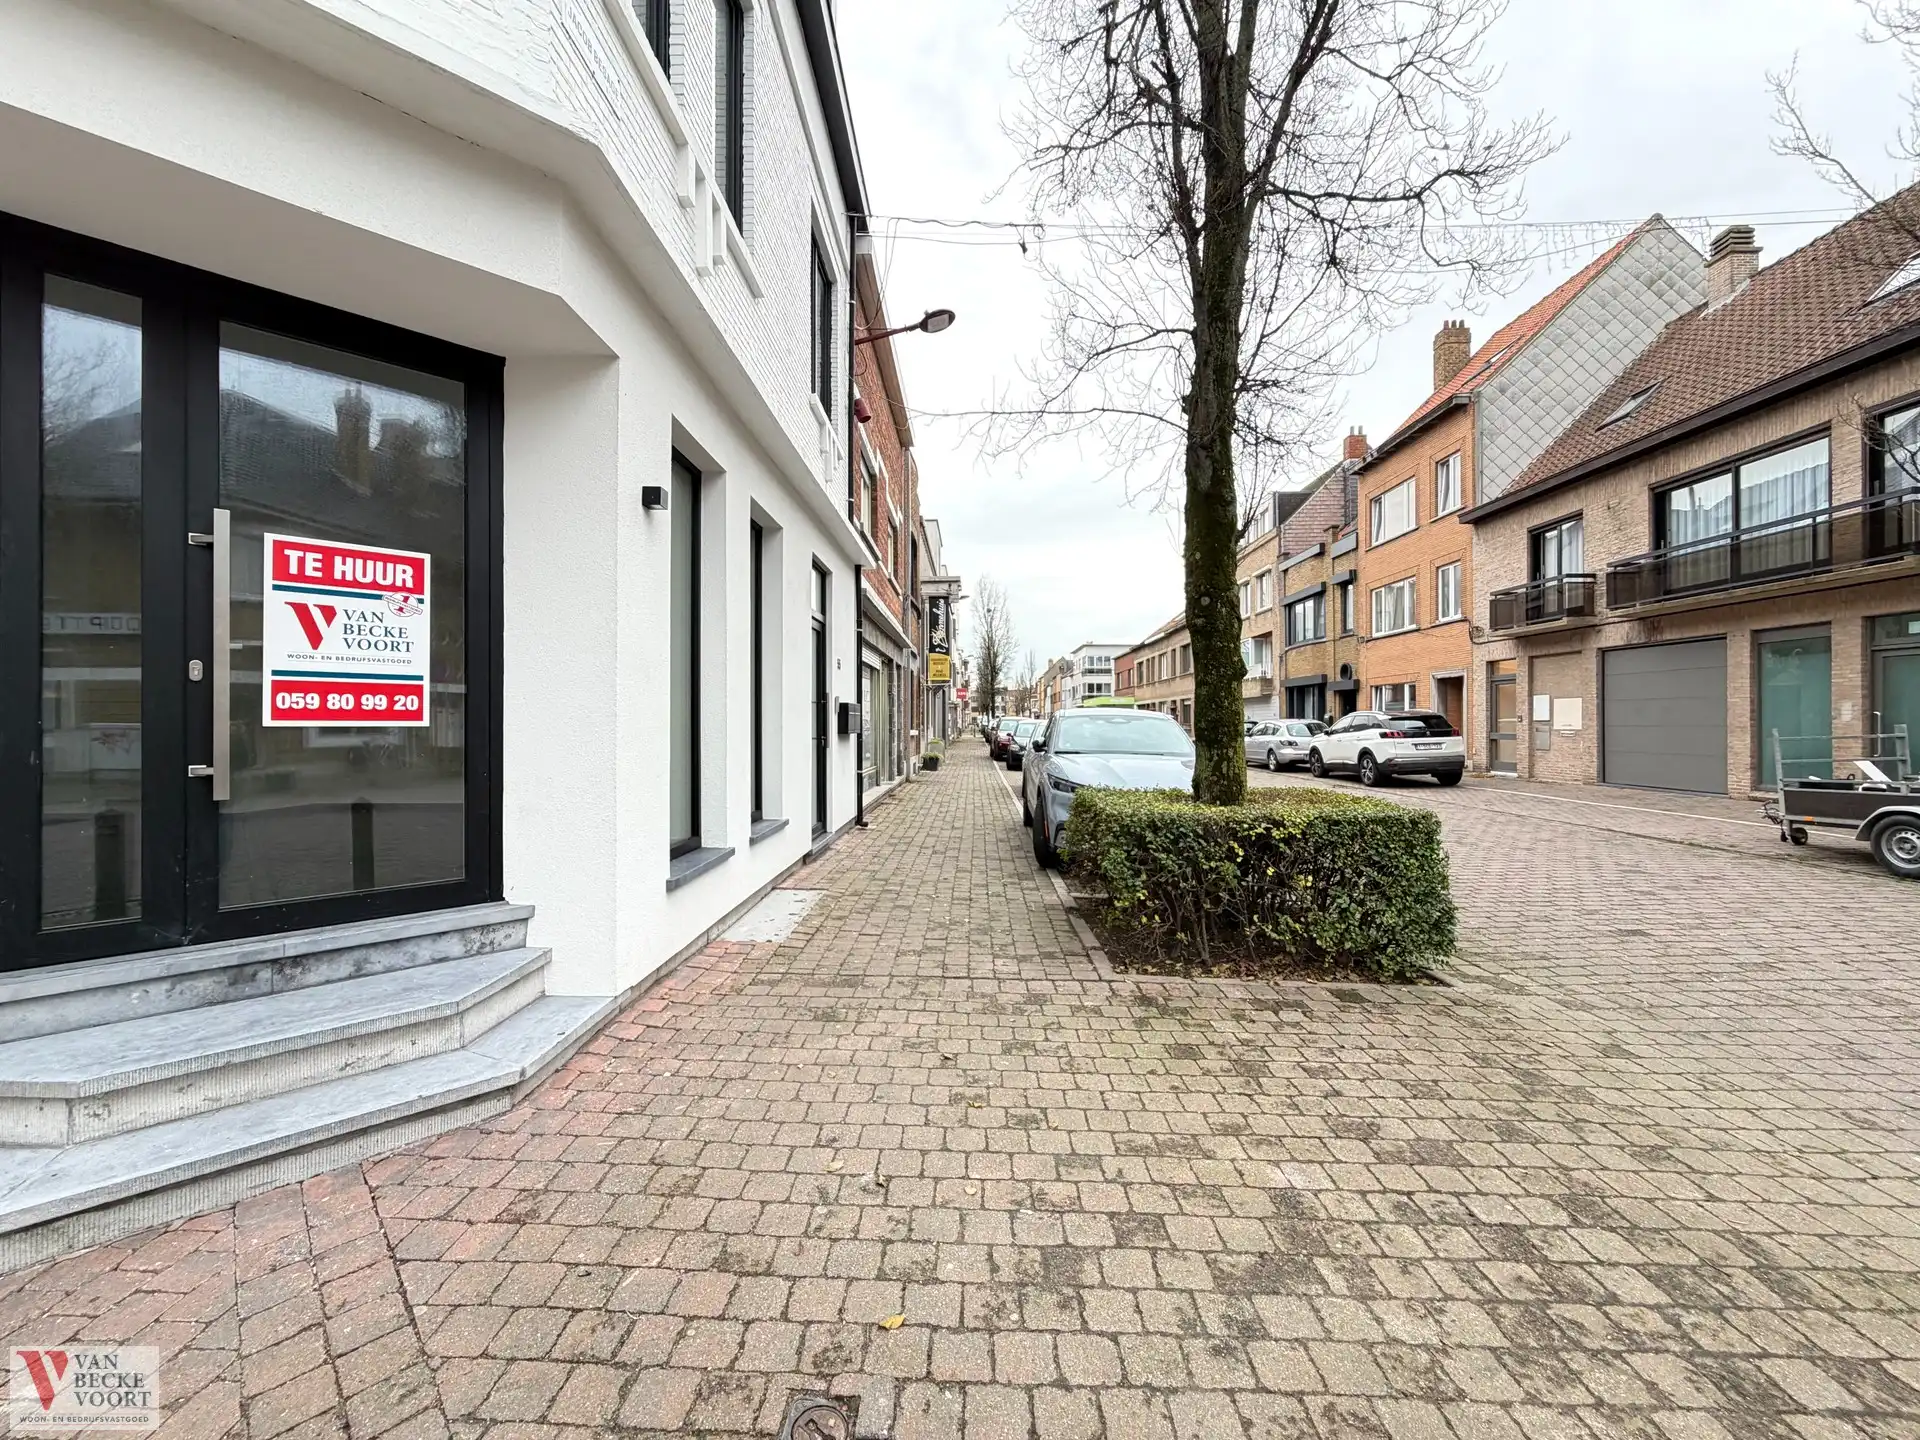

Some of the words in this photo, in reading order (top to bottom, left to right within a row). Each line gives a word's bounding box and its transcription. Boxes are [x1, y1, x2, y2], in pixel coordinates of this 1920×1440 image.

[284, 549, 322, 577] TE
[334, 555, 413, 588] HUUR
[342, 608, 384, 624] VAN
[342, 623, 408, 639] BECKE
[342, 637, 414, 653] VOORT
[335, 656, 412, 665] BEDRIJFSVASTGOED
[275, 692, 320, 710] 059
[326, 693, 355, 710] 80
[360, 694, 388, 711] 99
[393, 695, 419, 711] 20
